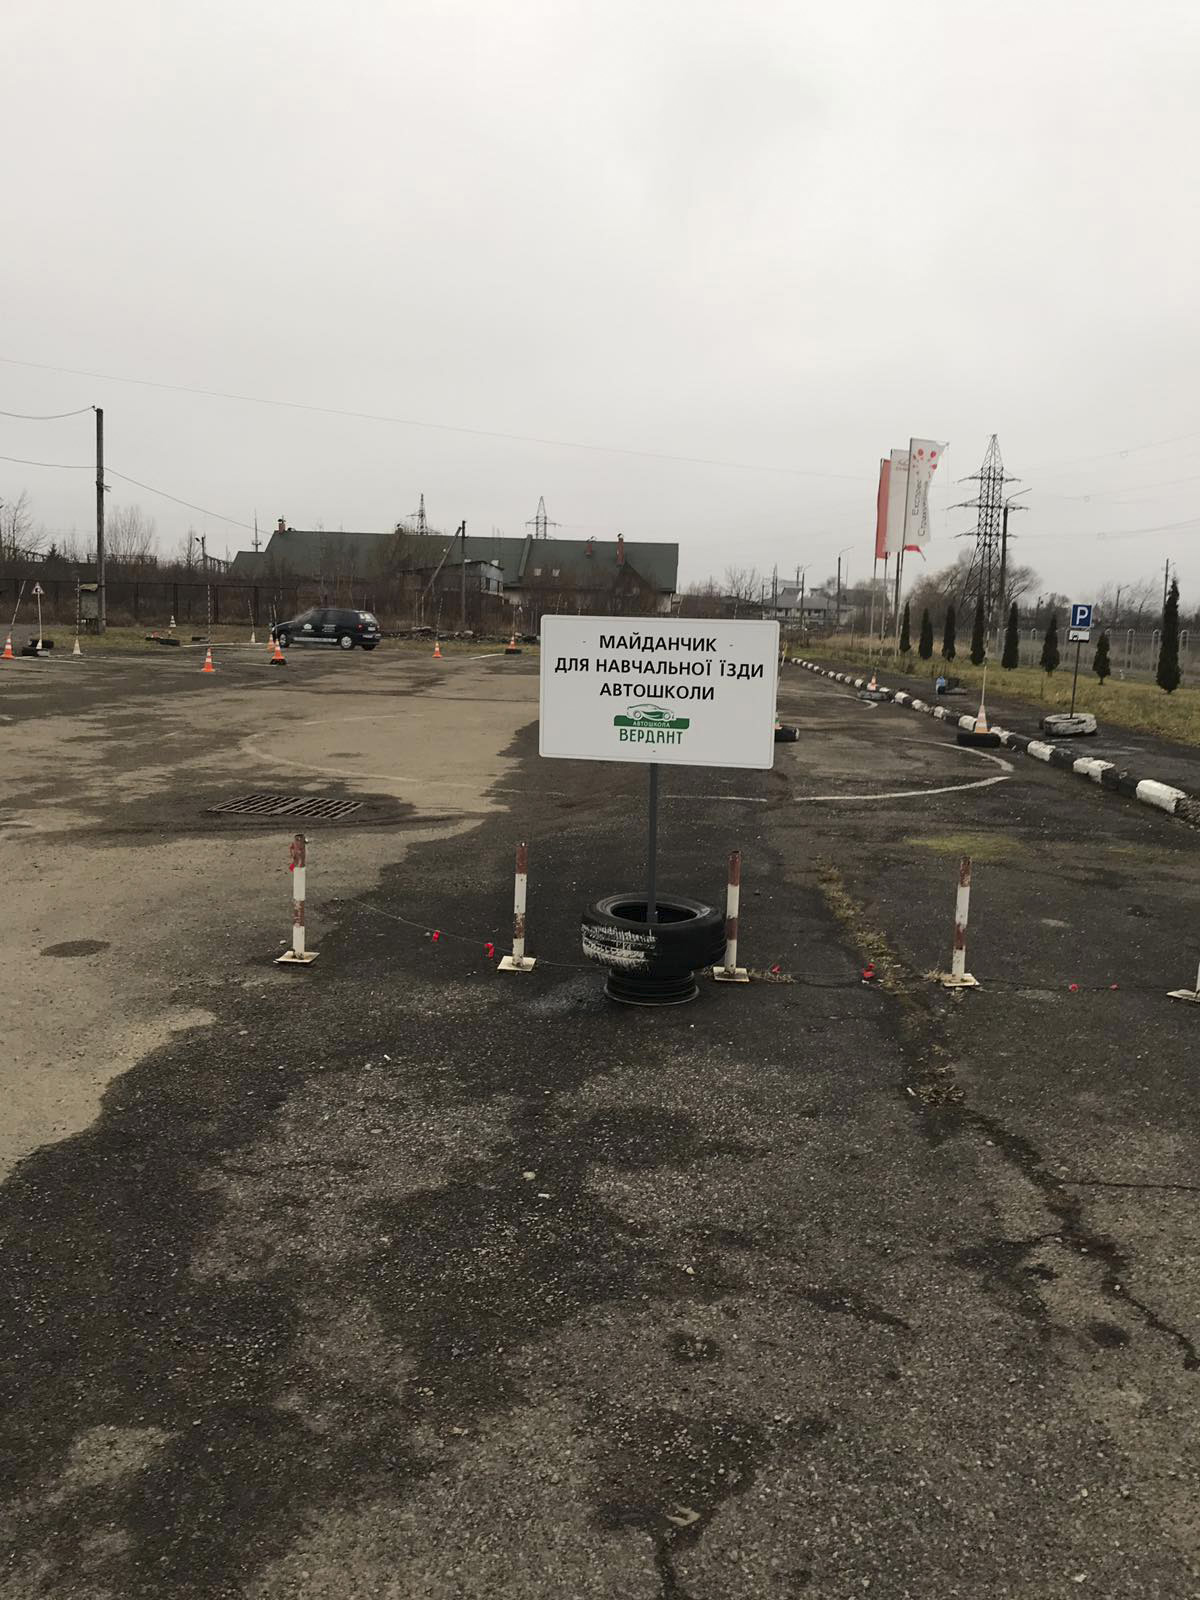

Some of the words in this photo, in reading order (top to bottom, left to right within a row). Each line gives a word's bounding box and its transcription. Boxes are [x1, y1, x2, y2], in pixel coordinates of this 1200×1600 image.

[599, 632, 717, 653] МАЙДАНЧИК
[554, 657, 589, 673] ДЛЯ
[596, 659, 712, 677] НАВЧАЛЬНОЇ
[719, 659, 764, 680] ЇЗДИ
[599, 683, 715, 701] АВТОШКОЛИ
[632, 720, 671, 728] АВТОШКОЛА
[619, 728, 683, 745] ВЕРДАНТ
